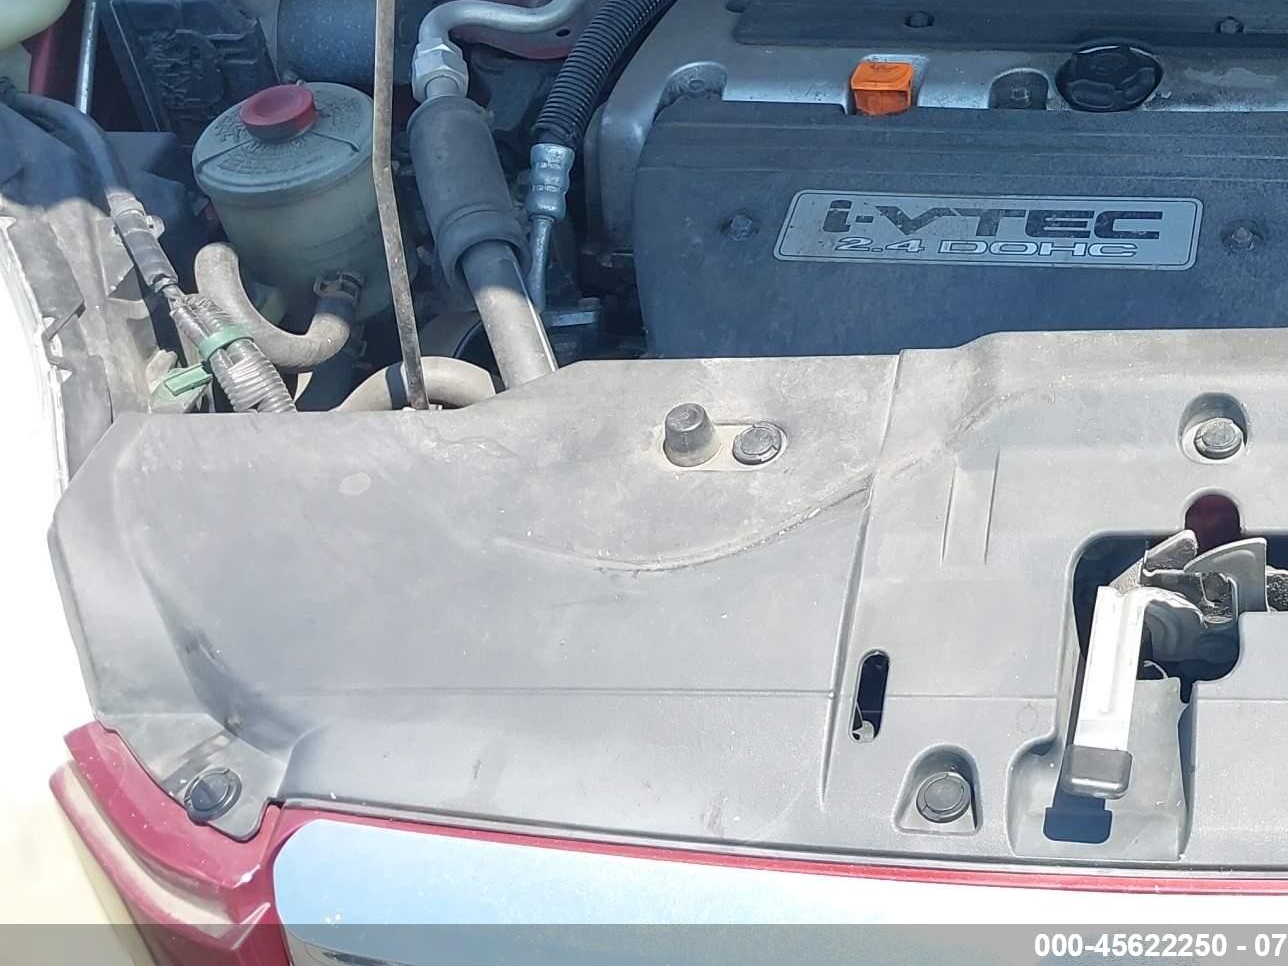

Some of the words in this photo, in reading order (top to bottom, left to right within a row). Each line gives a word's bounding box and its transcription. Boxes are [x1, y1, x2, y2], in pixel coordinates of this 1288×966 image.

[821, 198, 1161, 240] i-VTEC
[834, 236, 926, 255] 2.4
[937, 239, 1139, 259] DOHC
